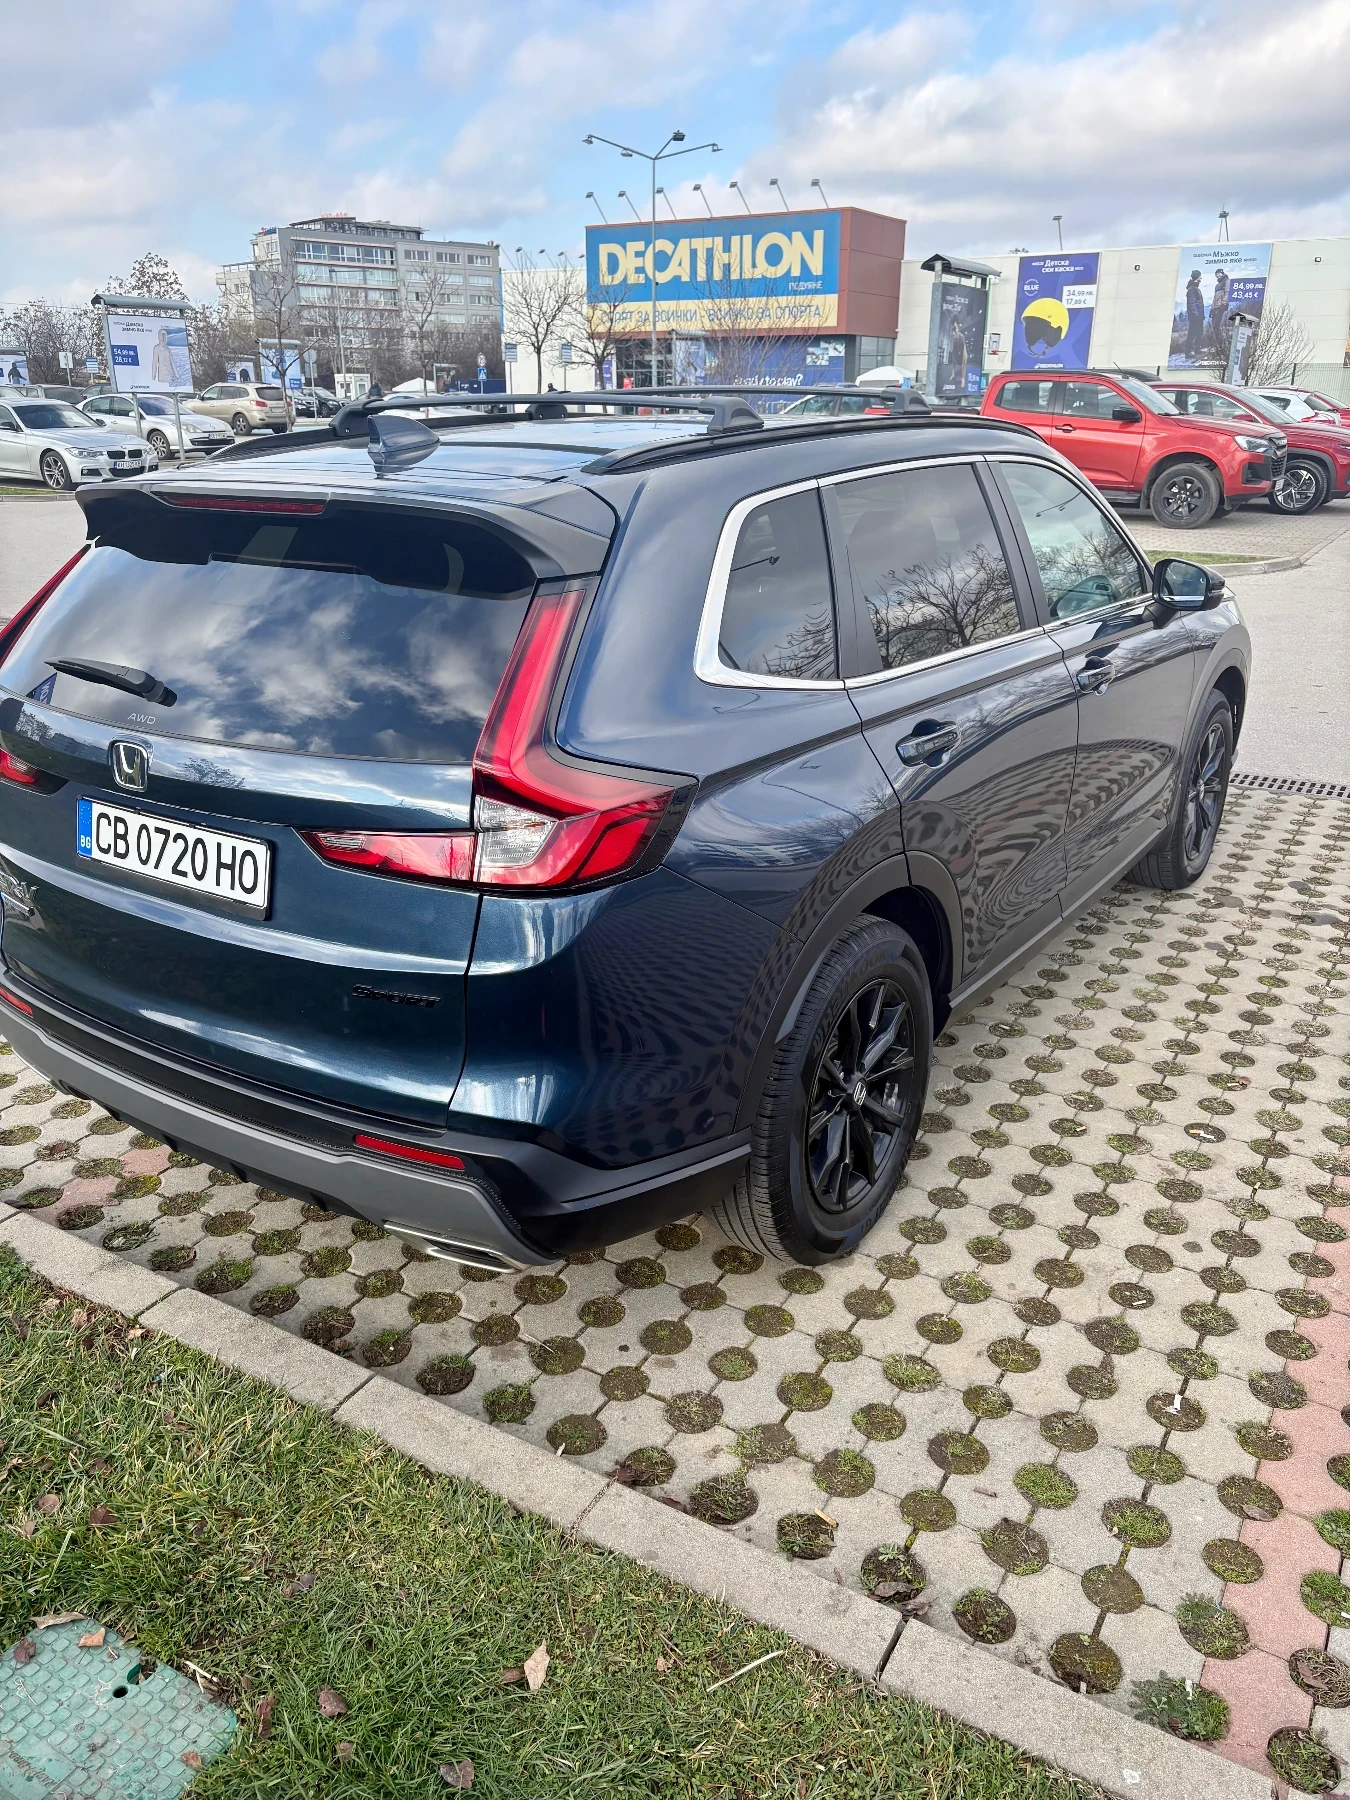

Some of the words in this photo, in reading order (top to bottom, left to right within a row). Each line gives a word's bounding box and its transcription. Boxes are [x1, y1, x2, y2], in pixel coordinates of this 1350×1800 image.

[599, 230, 824, 286] DECATHLON
[1233, 282, 1254, 290] 84,99
[1066, 289, 1085, 297] 34,99
[1232, 291, 1252, 299] 43,45
[636, 310, 650, 322] ЗА
[654, 309, 697, 322] ВСИЧКИ
[775, 304, 821, 319] СПОРТА
[113, 348, 128, 356] 54,99
[765, 375, 776, 386] to
[127, 712, 156, 725] AWD
[80, 834, 92, 849] BG
[96, 812, 130, 860] CB
[136, 823, 208, 881] 0720
[215, 841, 259, 895] HO
